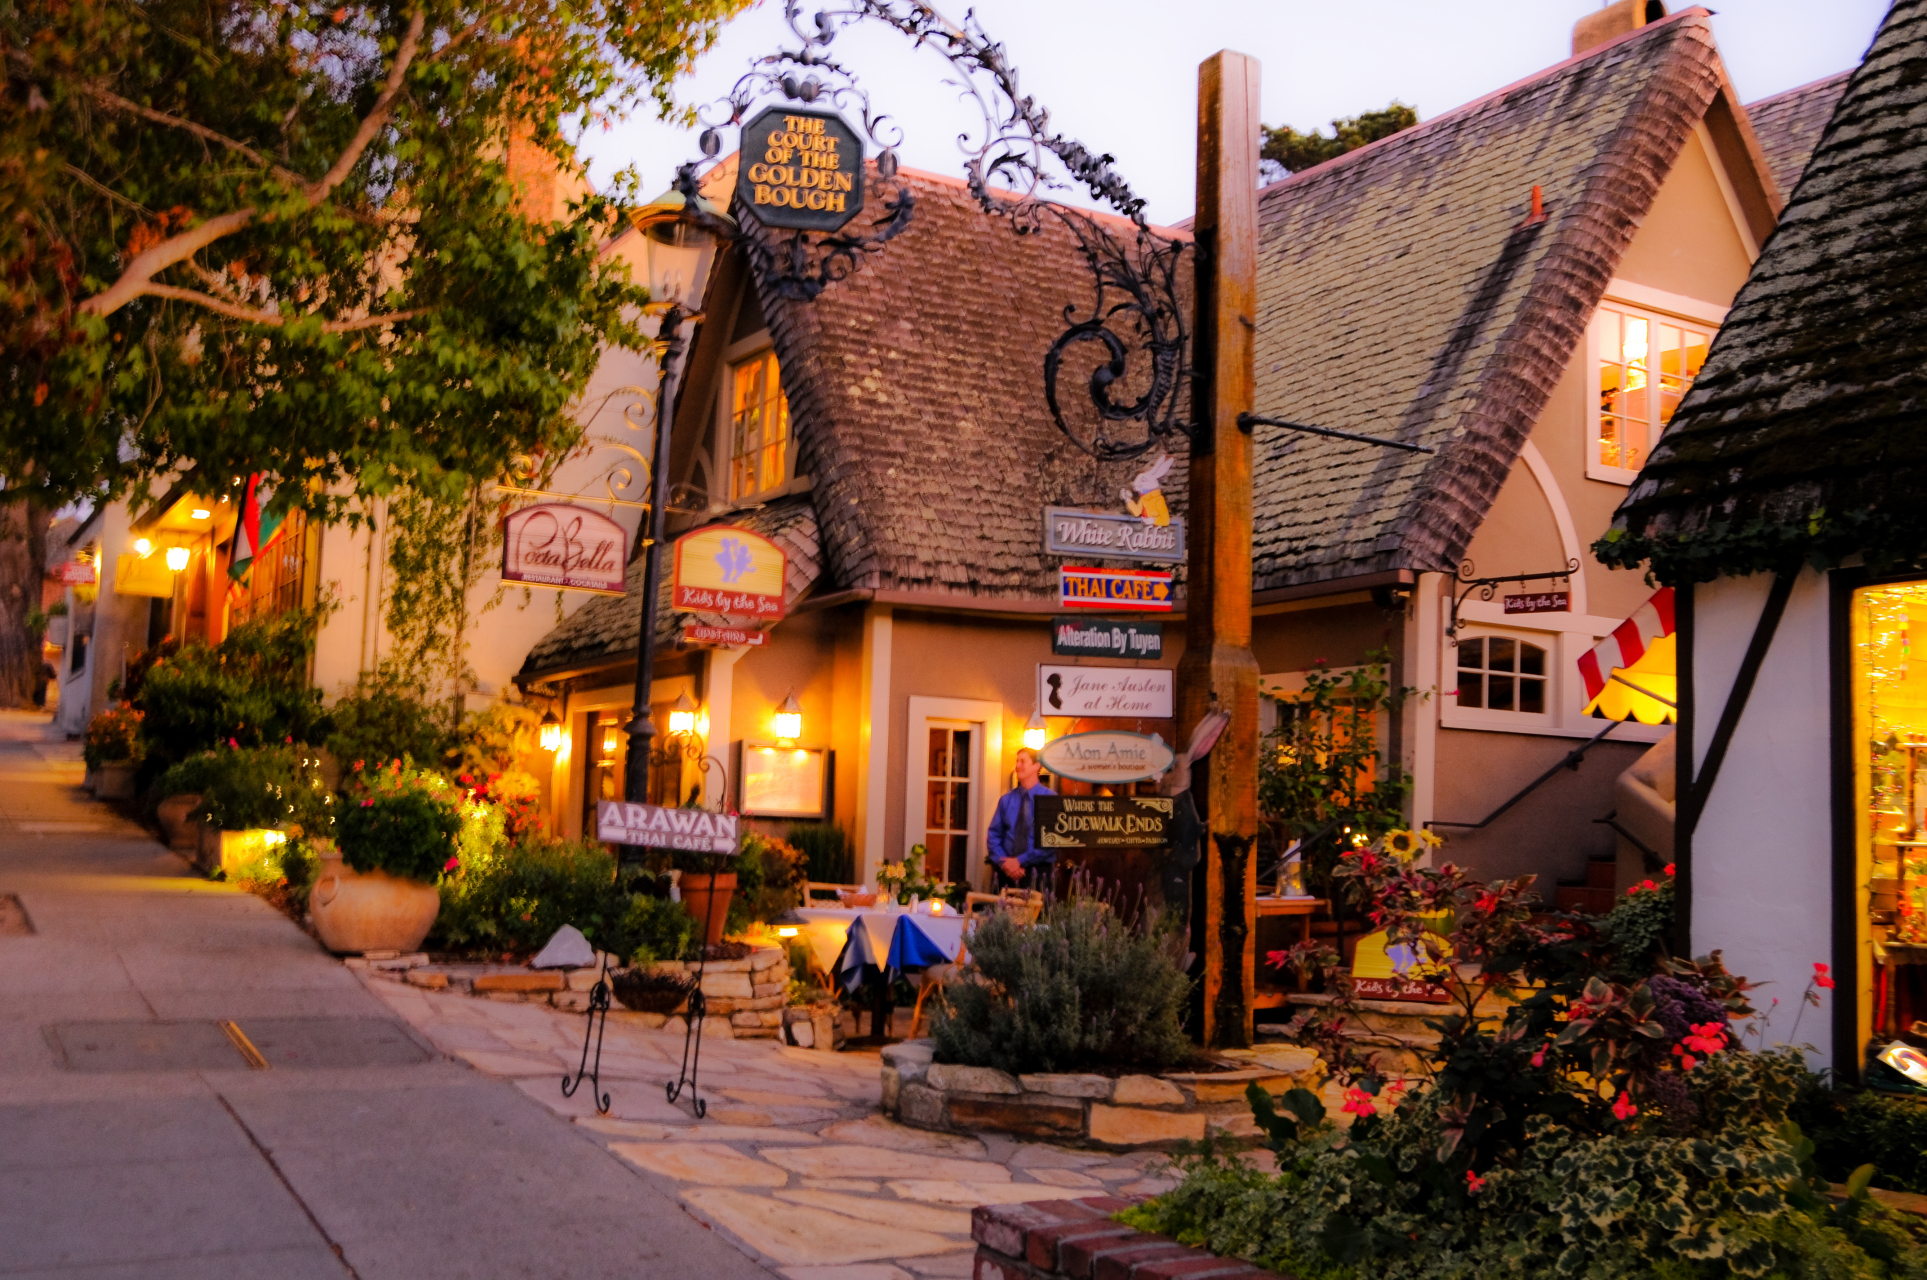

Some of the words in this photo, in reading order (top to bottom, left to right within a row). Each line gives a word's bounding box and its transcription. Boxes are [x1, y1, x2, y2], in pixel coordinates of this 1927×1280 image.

[783, 115, 826, 135] THE
[767, 130, 839, 152] COURT
[765, 146, 794, 164] OF
[798, 150, 840, 170] THE
[748, 162, 853, 192] GOLDEN
[753, 184, 846, 213] BOUGH
[1057, 519, 1113, 546] White
[1116, 525, 1176, 553] Rabbit
[522, 573, 564, 585] RESTAURANT
[569, 579, 608, 589] COCKTAILS
[1066, 577, 1107, 598] THAI
[682, 587, 714, 607] Kids
[716, 591, 731, 612] by
[733, 595, 755, 610] the
[756, 596, 779, 613] Sea
[1505, 597, 1524, 610] Kids
[1526, 597, 1536, 611] by
[1537, 595, 1551, 607] the
[1551, 594, 1568, 608] Sea
[1057, 625, 1111, 648] Alteration
[1111, 627, 1127, 654] By
[1128, 628, 1161, 655] Tuyen
[1068, 674, 1109, 697] Jane
[1112, 676, 1167, 693] Austen
[1084, 696, 1103, 710] at
[1106, 694, 1153, 711] Home
[1064, 742, 1101, 760] Mon
[1107, 741, 1147, 760] Amie
[1118, 762, 1146, 771] boutique
[1063, 798, 1095, 813] WHERE
[1098, 800, 1115, 812] THE
[600, 801, 737, 839] ARAWAN
[1054, 812, 1129, 835] SIDEWALK
[1126, 814, 1163, 833] ENDS
[627, 830, 667, 846] THAI
[1355, 980, 1384, 994] Kids
[1402, 981, 1423, 995] the
